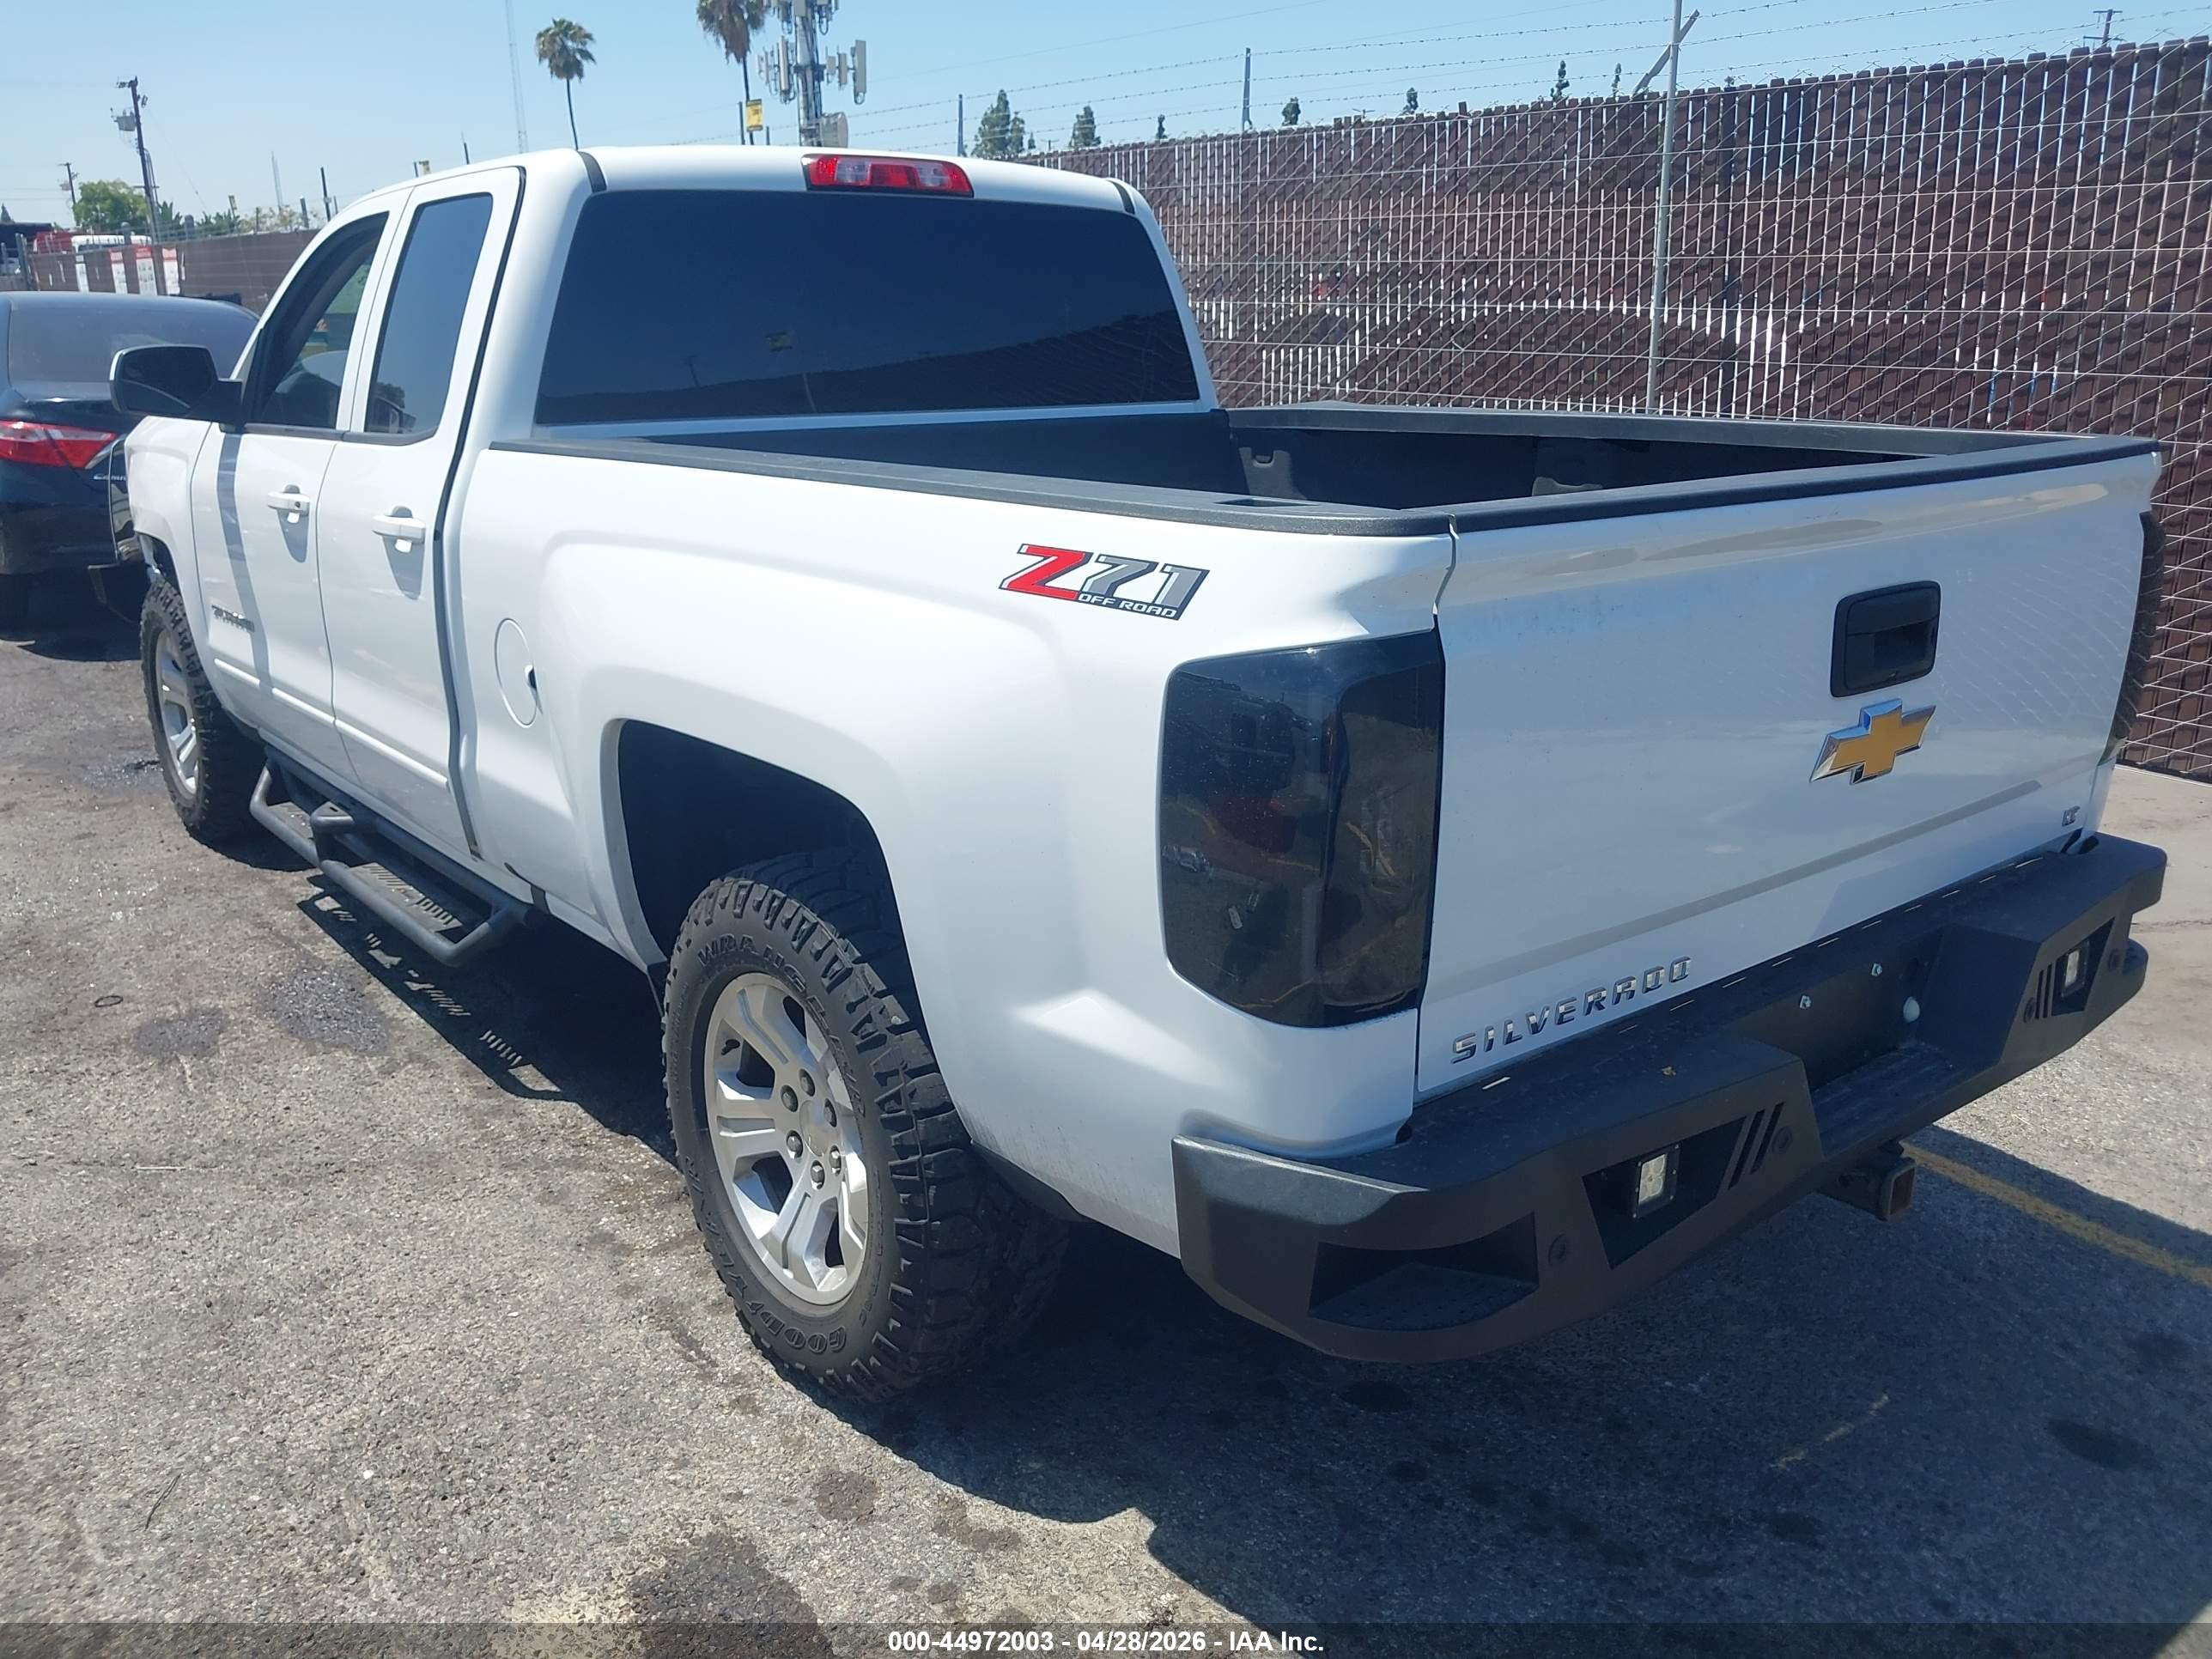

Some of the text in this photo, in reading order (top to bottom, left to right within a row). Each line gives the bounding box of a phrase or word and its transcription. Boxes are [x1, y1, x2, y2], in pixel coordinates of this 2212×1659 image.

[999, 543, 1210, 610] Z71
[1078, 592, 1177, 619] OFF ROAD
[1451, 956, 1691, 1064] SILVERADO
